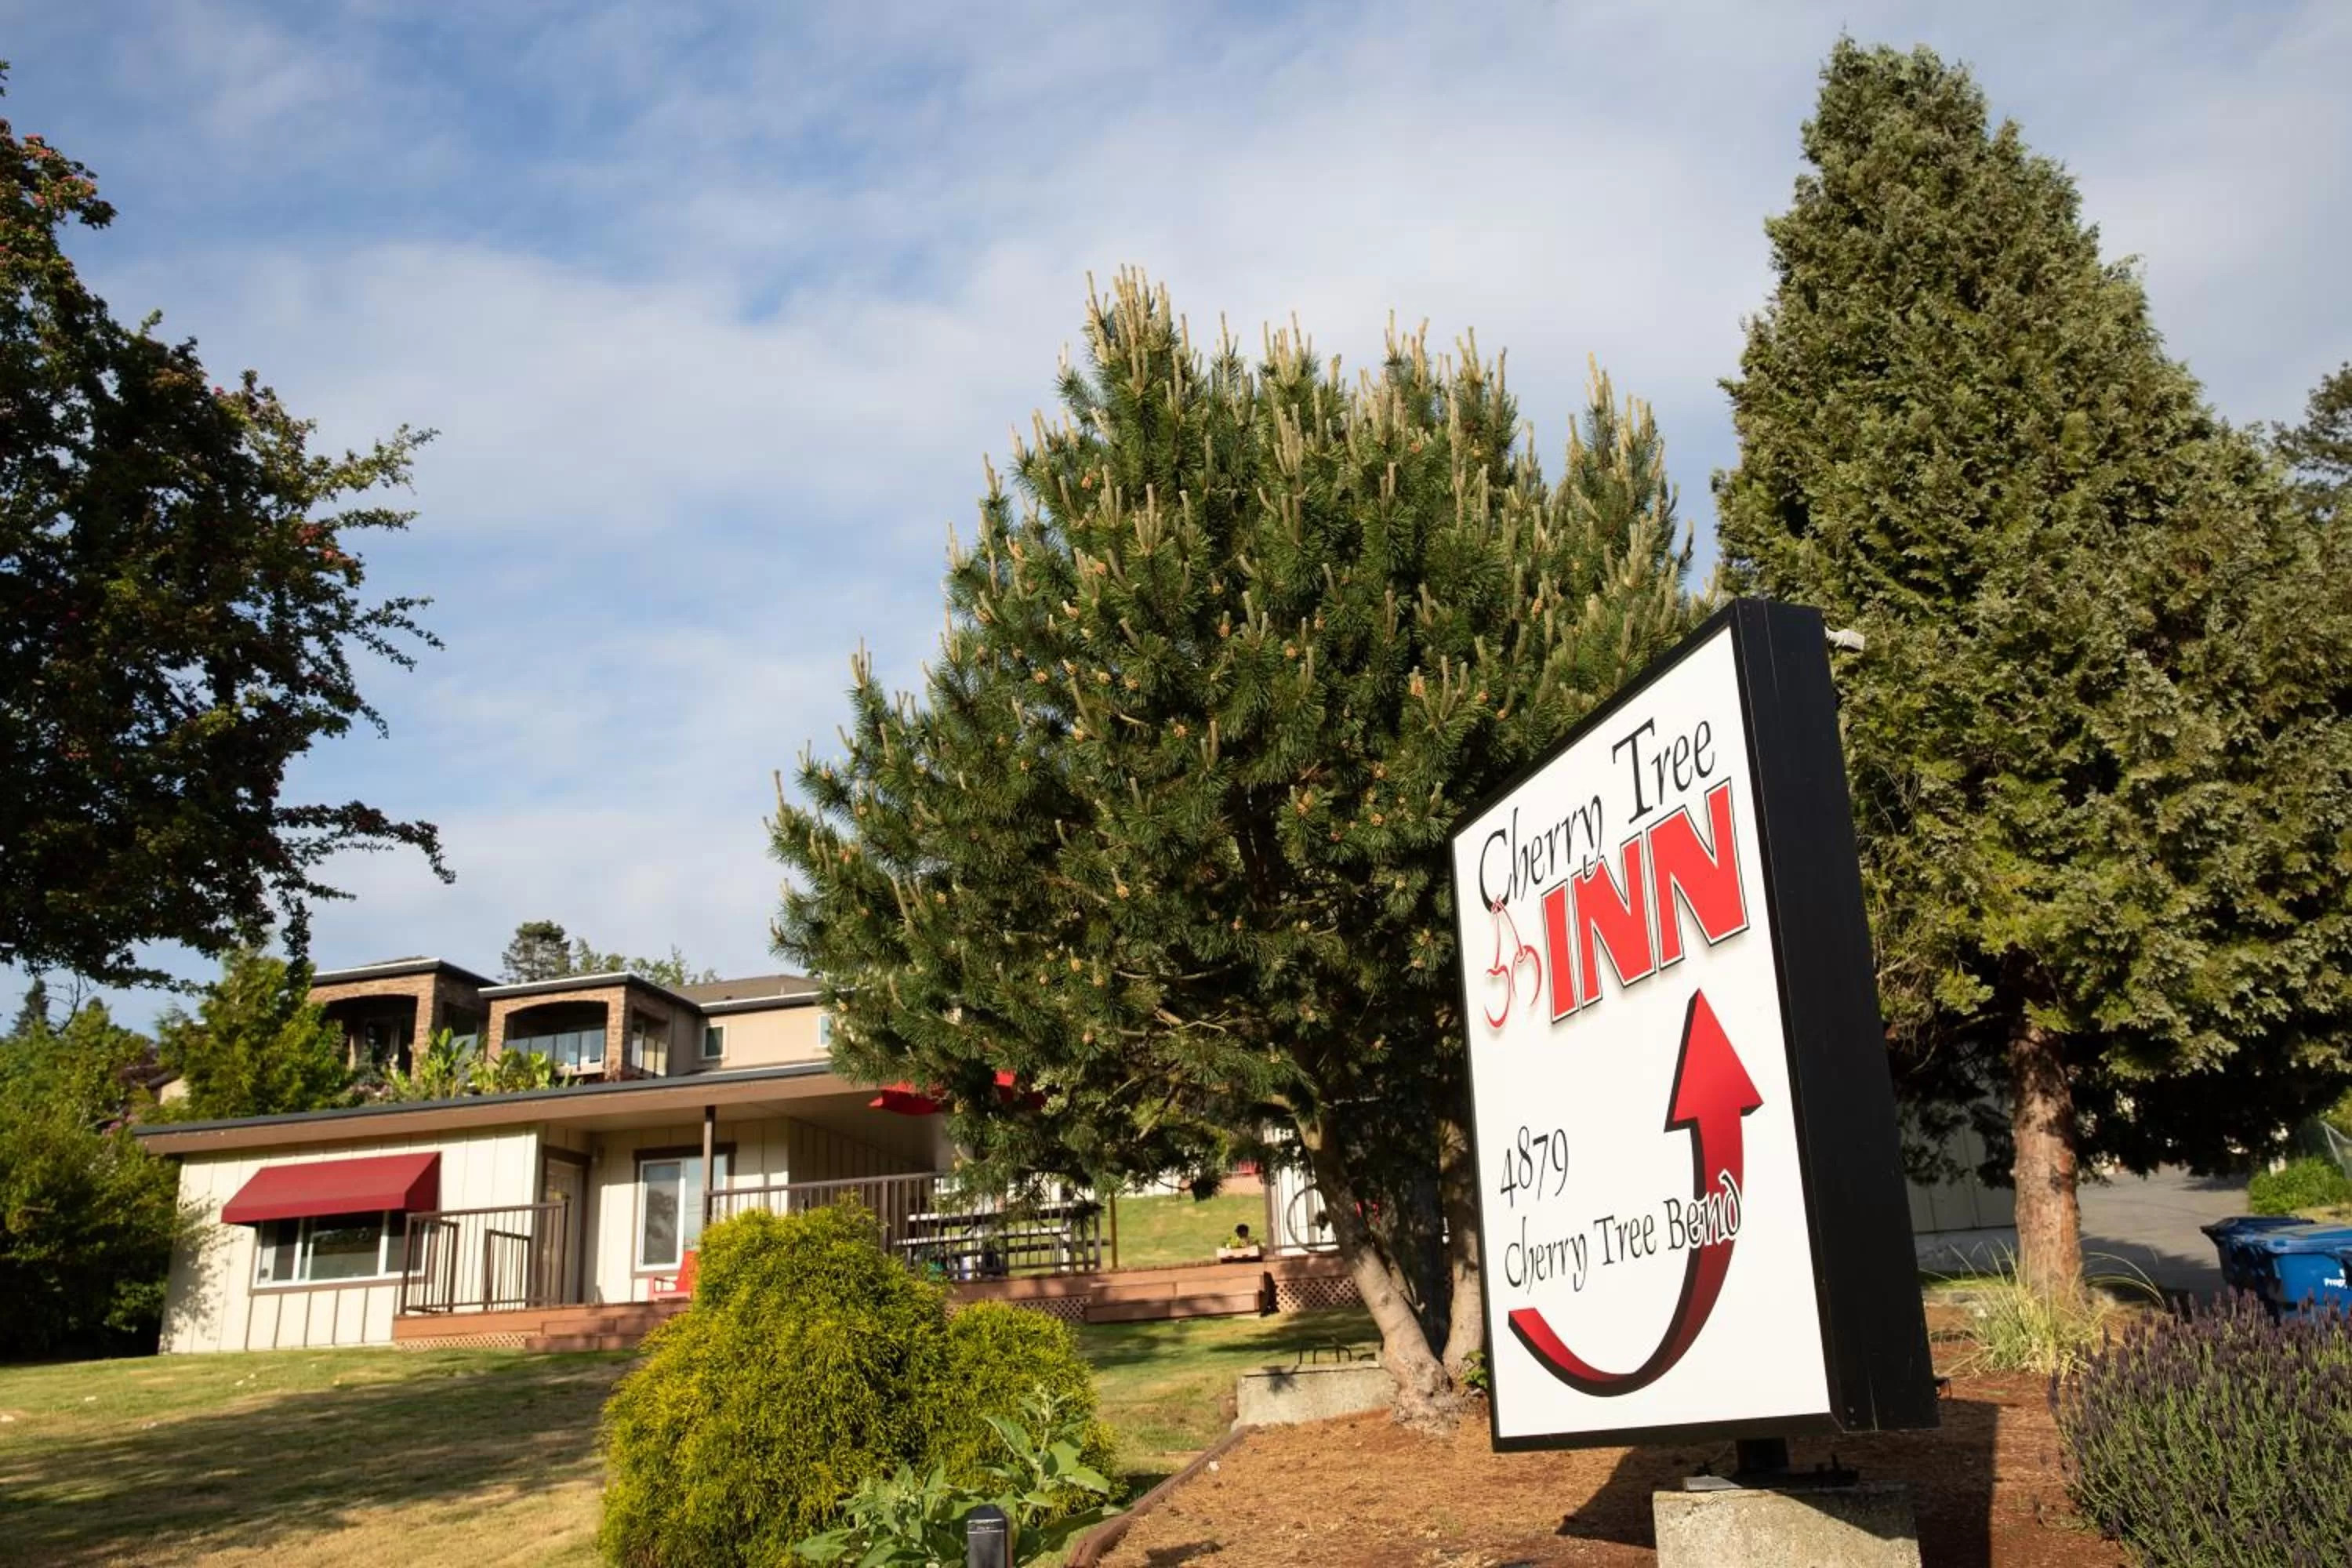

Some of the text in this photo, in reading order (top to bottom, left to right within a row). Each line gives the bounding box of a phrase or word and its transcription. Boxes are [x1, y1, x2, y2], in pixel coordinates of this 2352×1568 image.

[1479, 717, 1715, 913] Cherry Tree
[1541, 777, 1749, 1023] INN
[1501, 1126, 1569, 1208] 4879
[1505, 1171, 1741, 1295] Cherry Tree Bend
